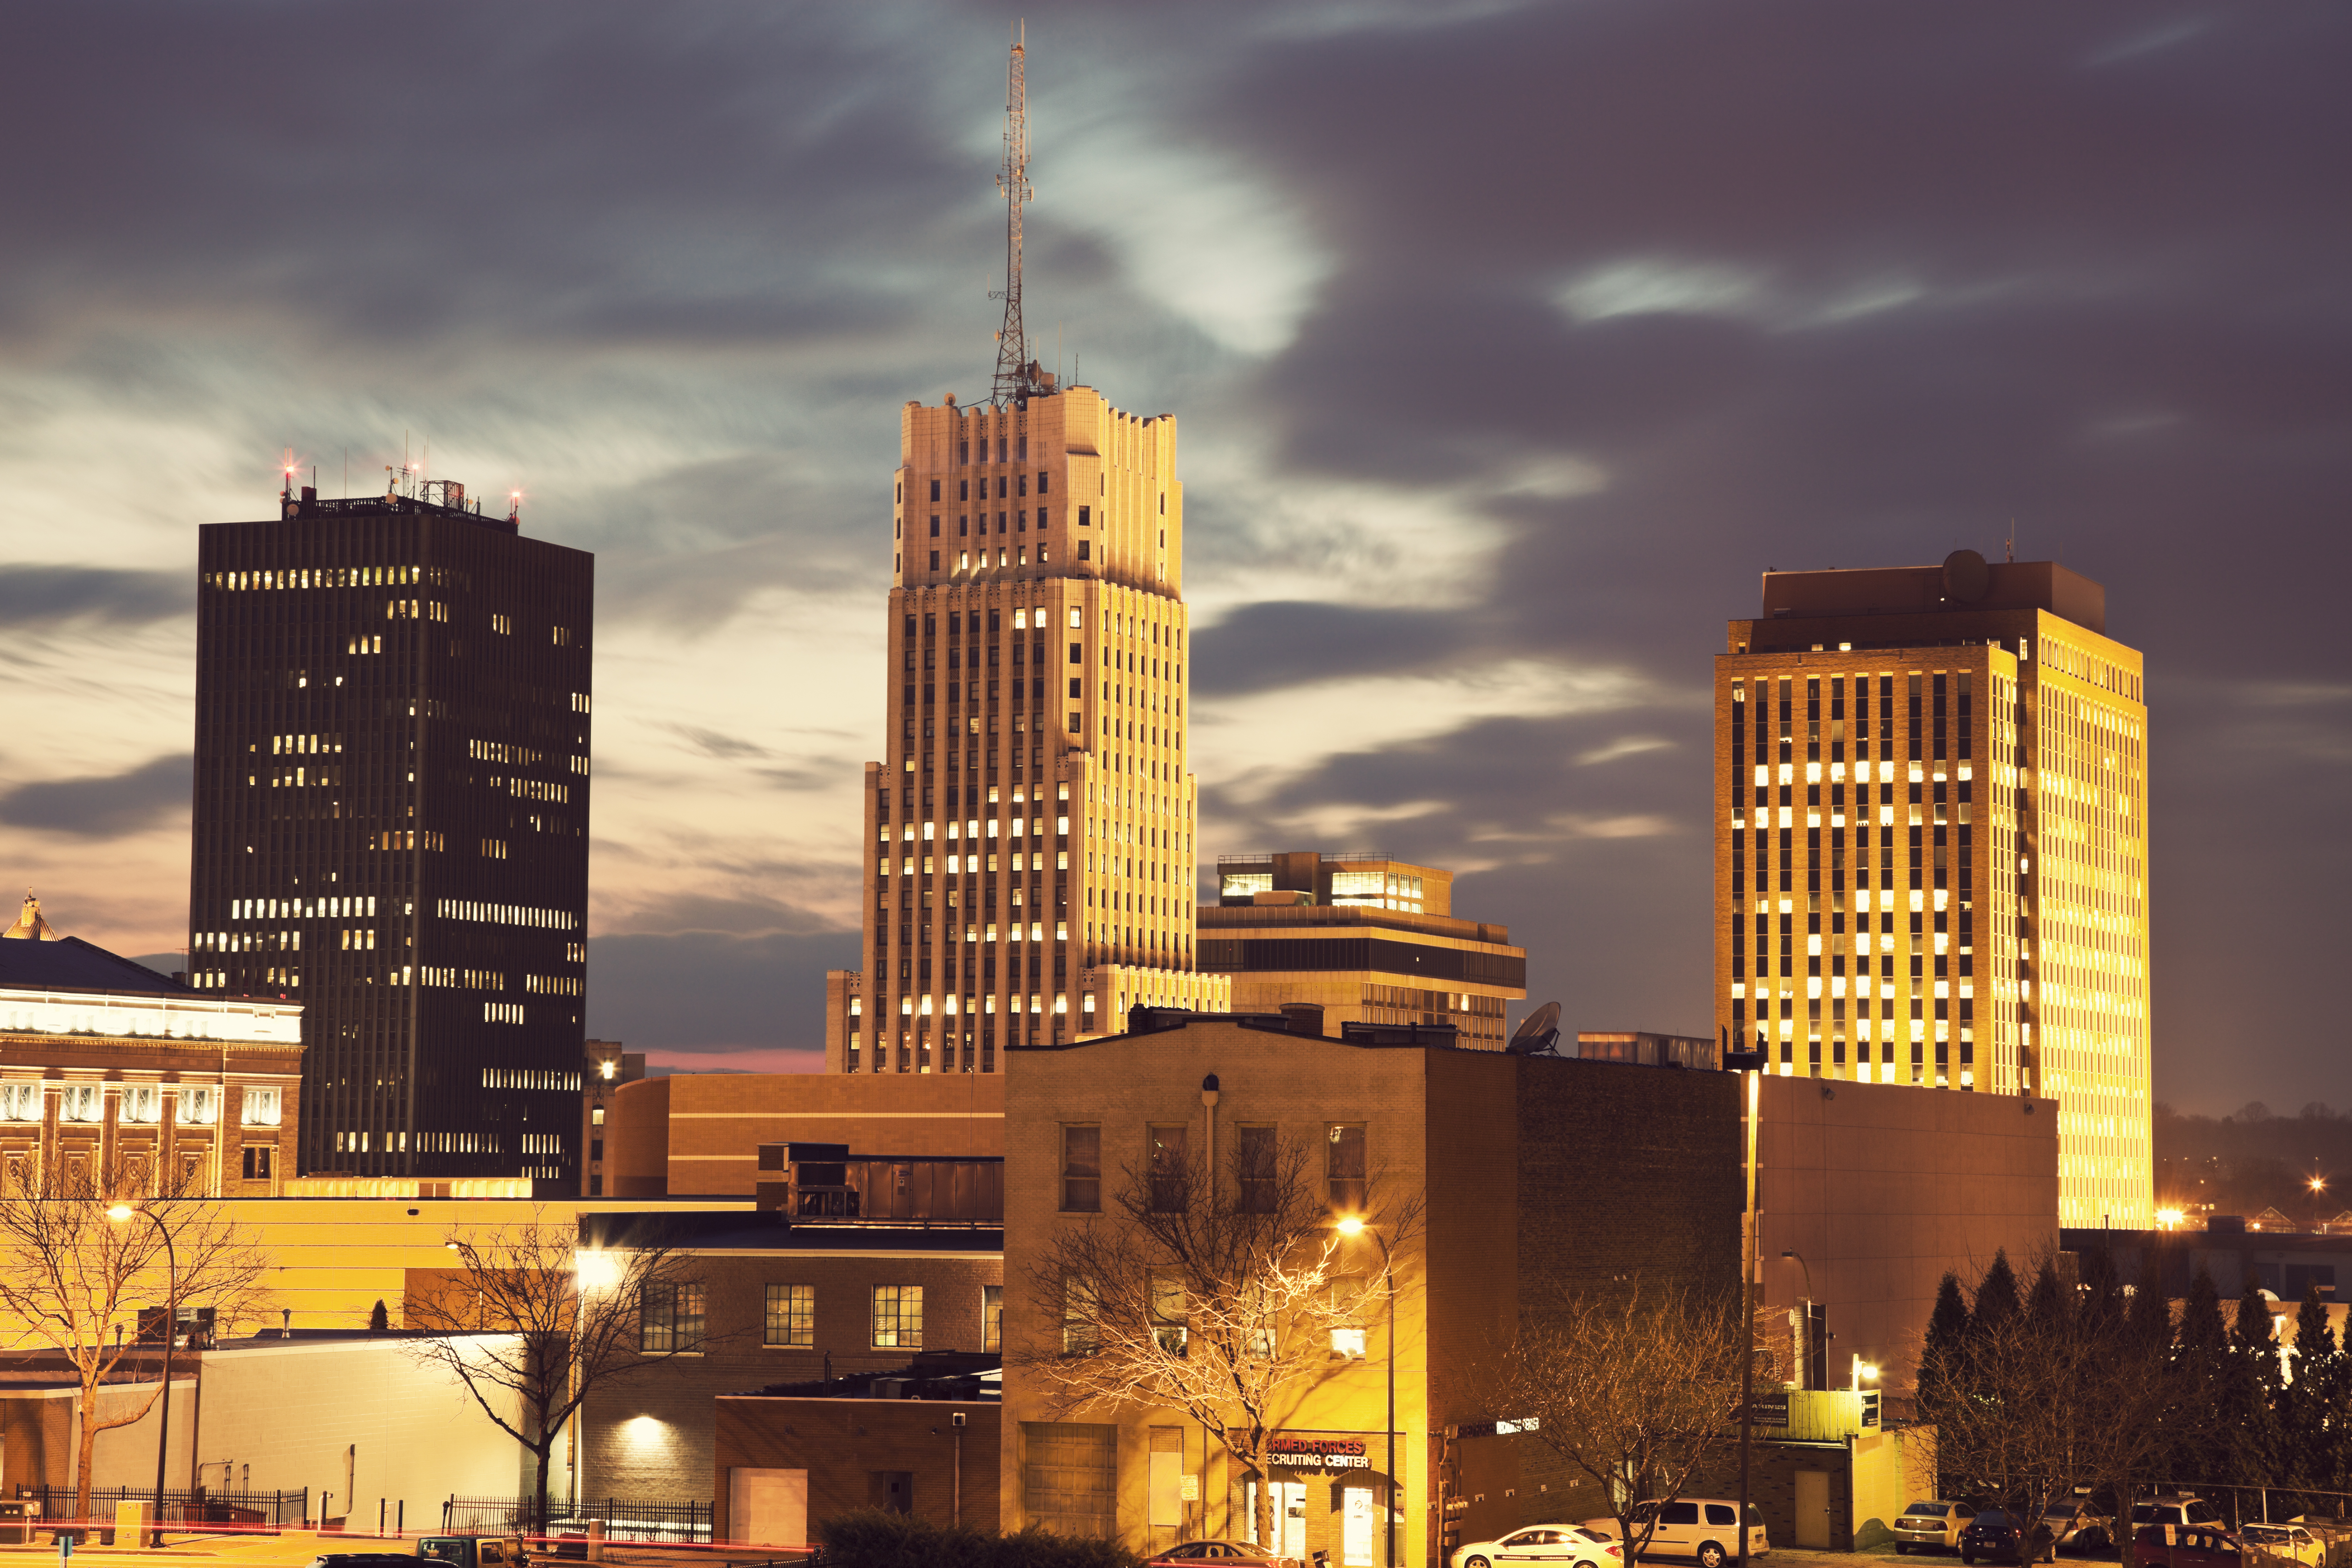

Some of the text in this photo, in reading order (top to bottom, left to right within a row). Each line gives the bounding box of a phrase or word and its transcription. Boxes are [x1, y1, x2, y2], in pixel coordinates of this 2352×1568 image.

[1312, 1440, 1362, 1454] FORCES
[1266, 1454, 1368, 1467] ECRUITING CENTER
